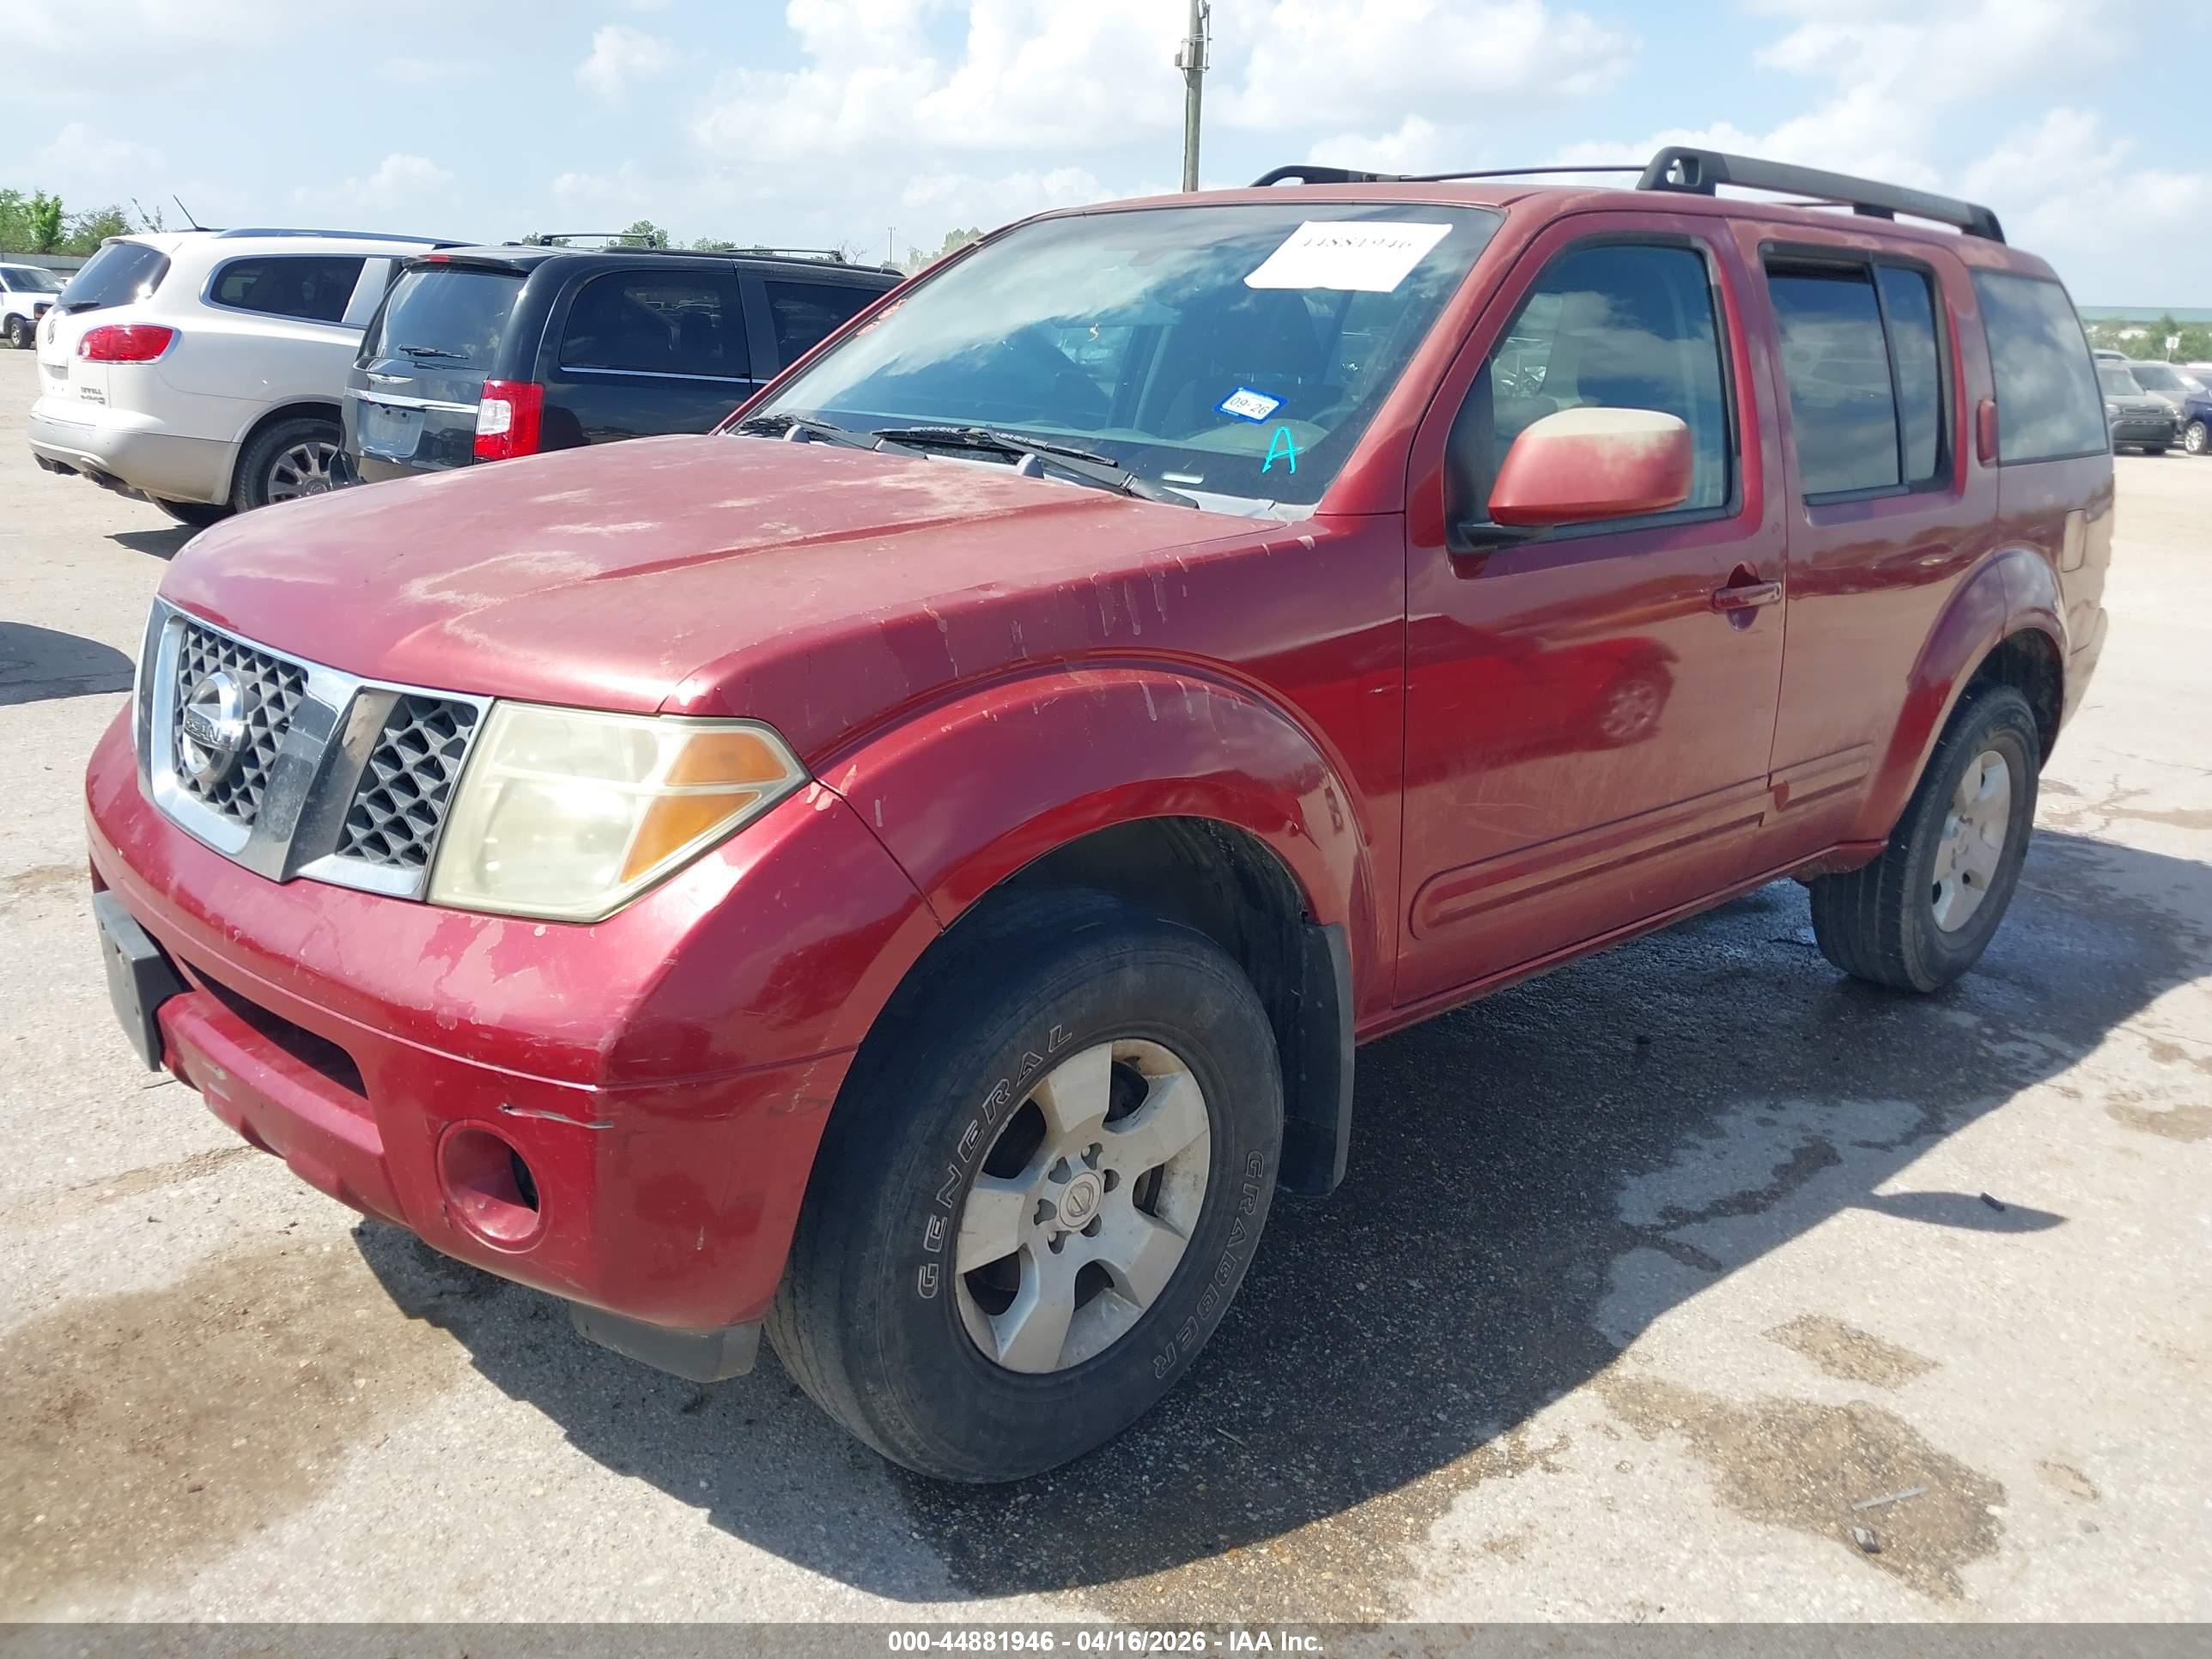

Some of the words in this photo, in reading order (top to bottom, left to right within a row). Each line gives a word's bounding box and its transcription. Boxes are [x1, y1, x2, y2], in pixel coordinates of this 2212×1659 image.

[1261, 426, 1304, 474] A
[918, 1024, 1073, 1299] GENERAL
[1152, 1151, 1264, 1379] GRABBER
